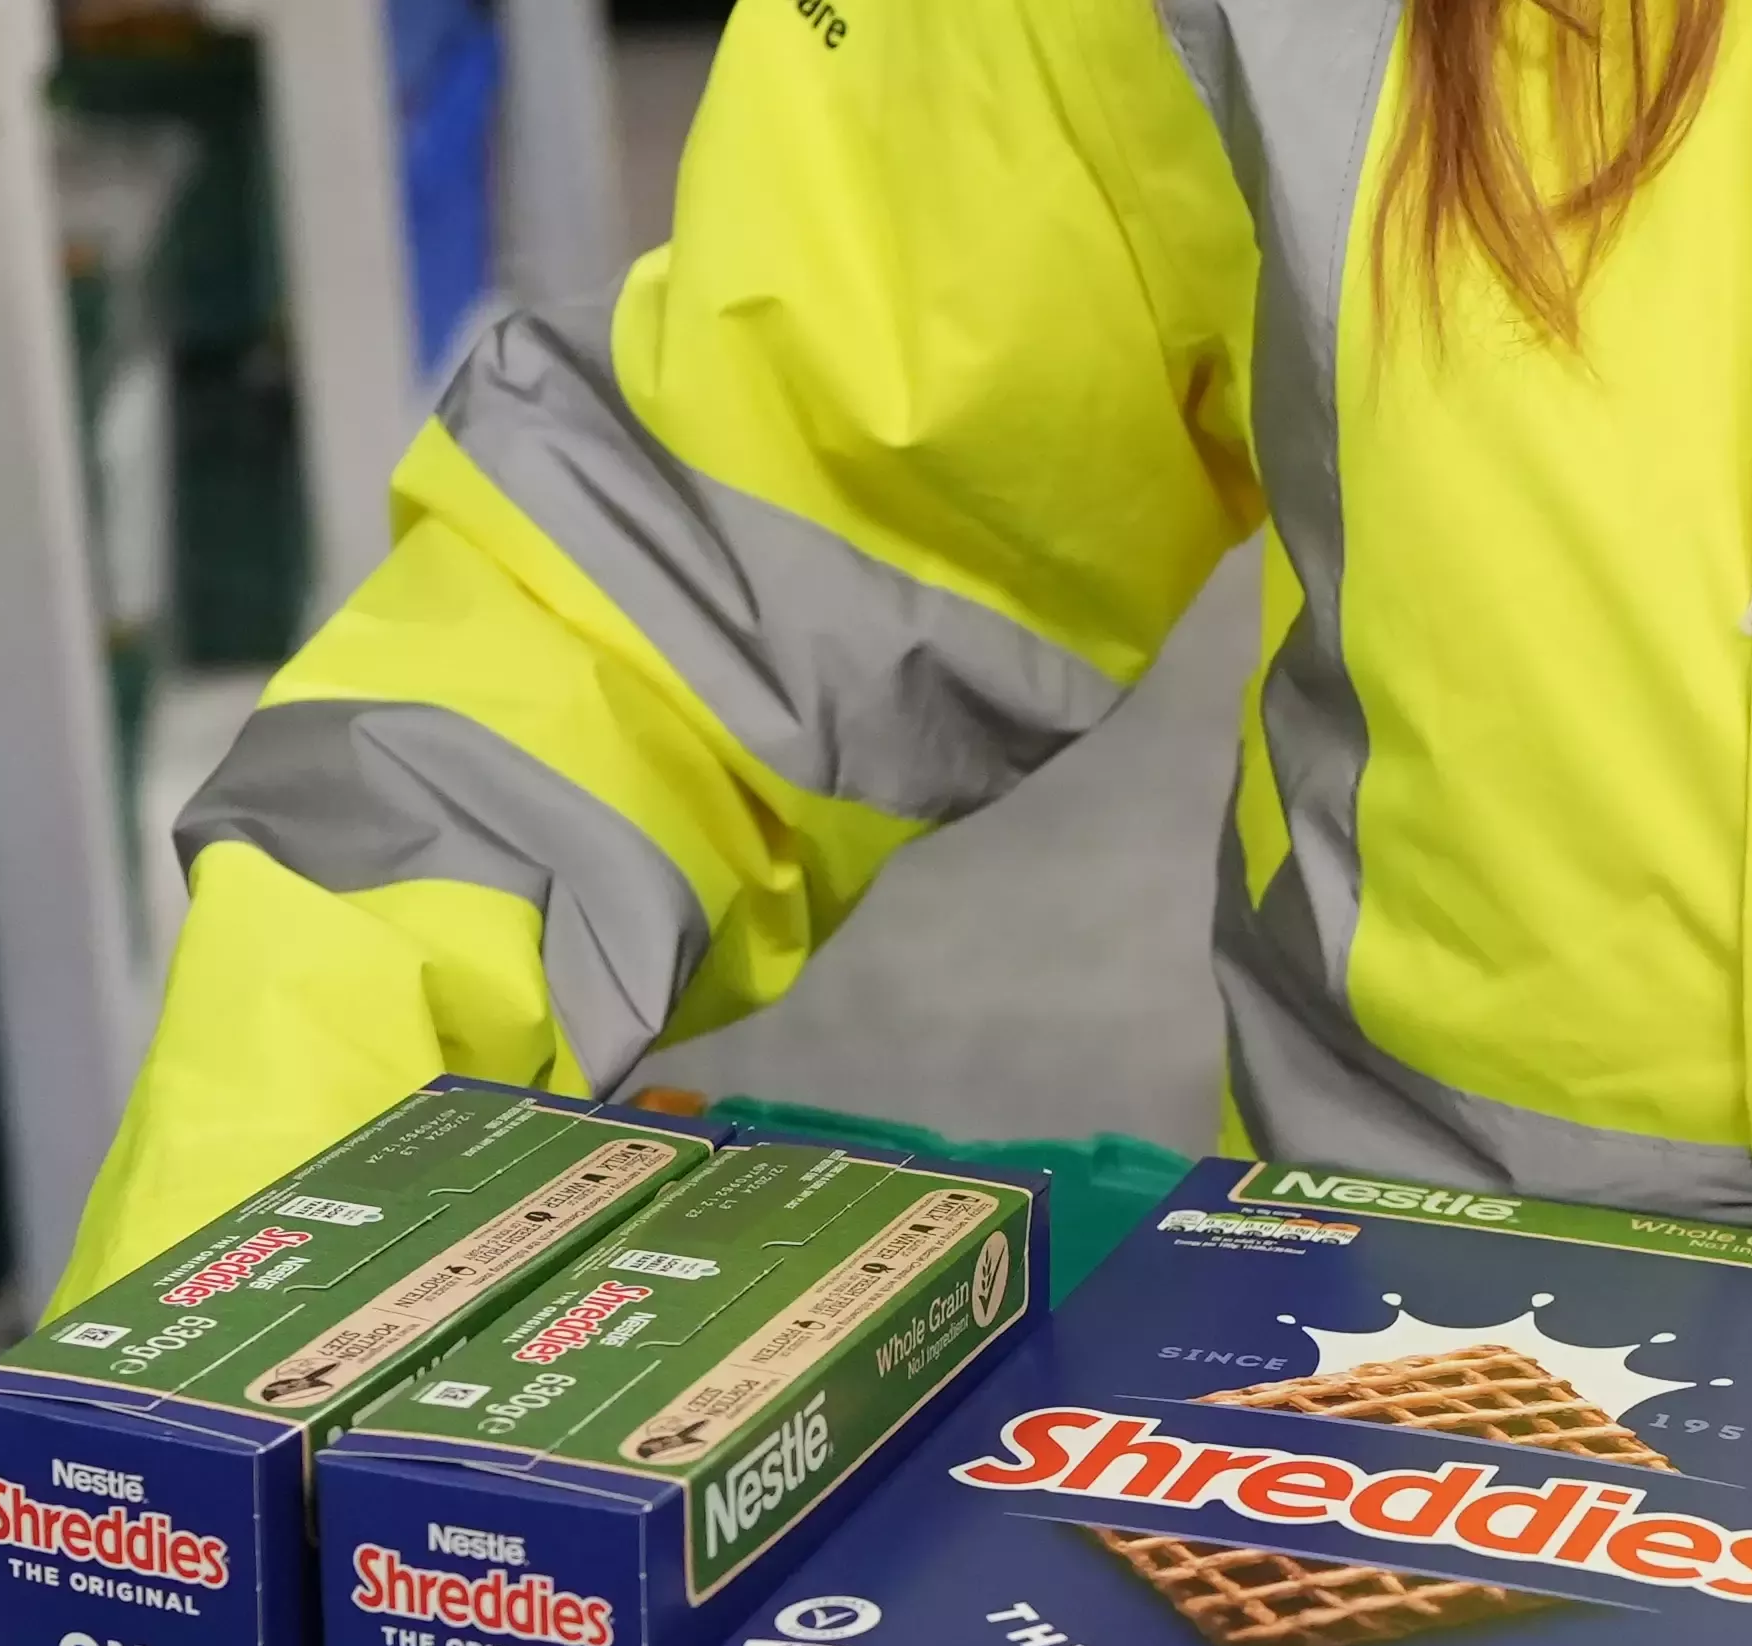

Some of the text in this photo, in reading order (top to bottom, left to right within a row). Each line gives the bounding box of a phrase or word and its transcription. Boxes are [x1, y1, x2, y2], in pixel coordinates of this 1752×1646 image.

[596, 1149, 636, 1170] MILK
[540, 1180, 589, 1208] WATER
[921, 1200, 958, 1220] MILK
[1272, 1171, 1522, 1221] Nestlé
[873, 1232, 918, 1259] WATER
[1629, 1217, 1736, 1242] Whole
[149, 1234, 240, 1287] THE ORIGINAL
[154, 1226, 313, 1309] Shreddies
[245, 1256, 310, 1290] Nestlé
[392, 1272, 452, 1308] PROTEIN
[119, 1313, 217, 1360] 630g
[499, 1289, 579, 1344] THE ORIGINAL
[507, 1280, 654, 1366] Shreddies
[596, 1311, 658, 1347] Nestlé
[876, 1315, 925, 1378] Whole
[929, 1281, 969, 1333] Grain
[315, 1330, 361, 1355] SIZE?
[335, 1323, 398, 1360] PORTION
[747, 1328, 803, 1363] PROTEIN
[1157, 1344, 1289, 1371] SINCE
[483, 1370, 577, 1419] 630g
[52, 1458, 145, 1502] Nestlé
[705, 1390, 828, 1559] Nestlé
[428, 1522, 526, 1566] Nestlé
[8, 1558, 200, 1616] THE ORIGINAL
